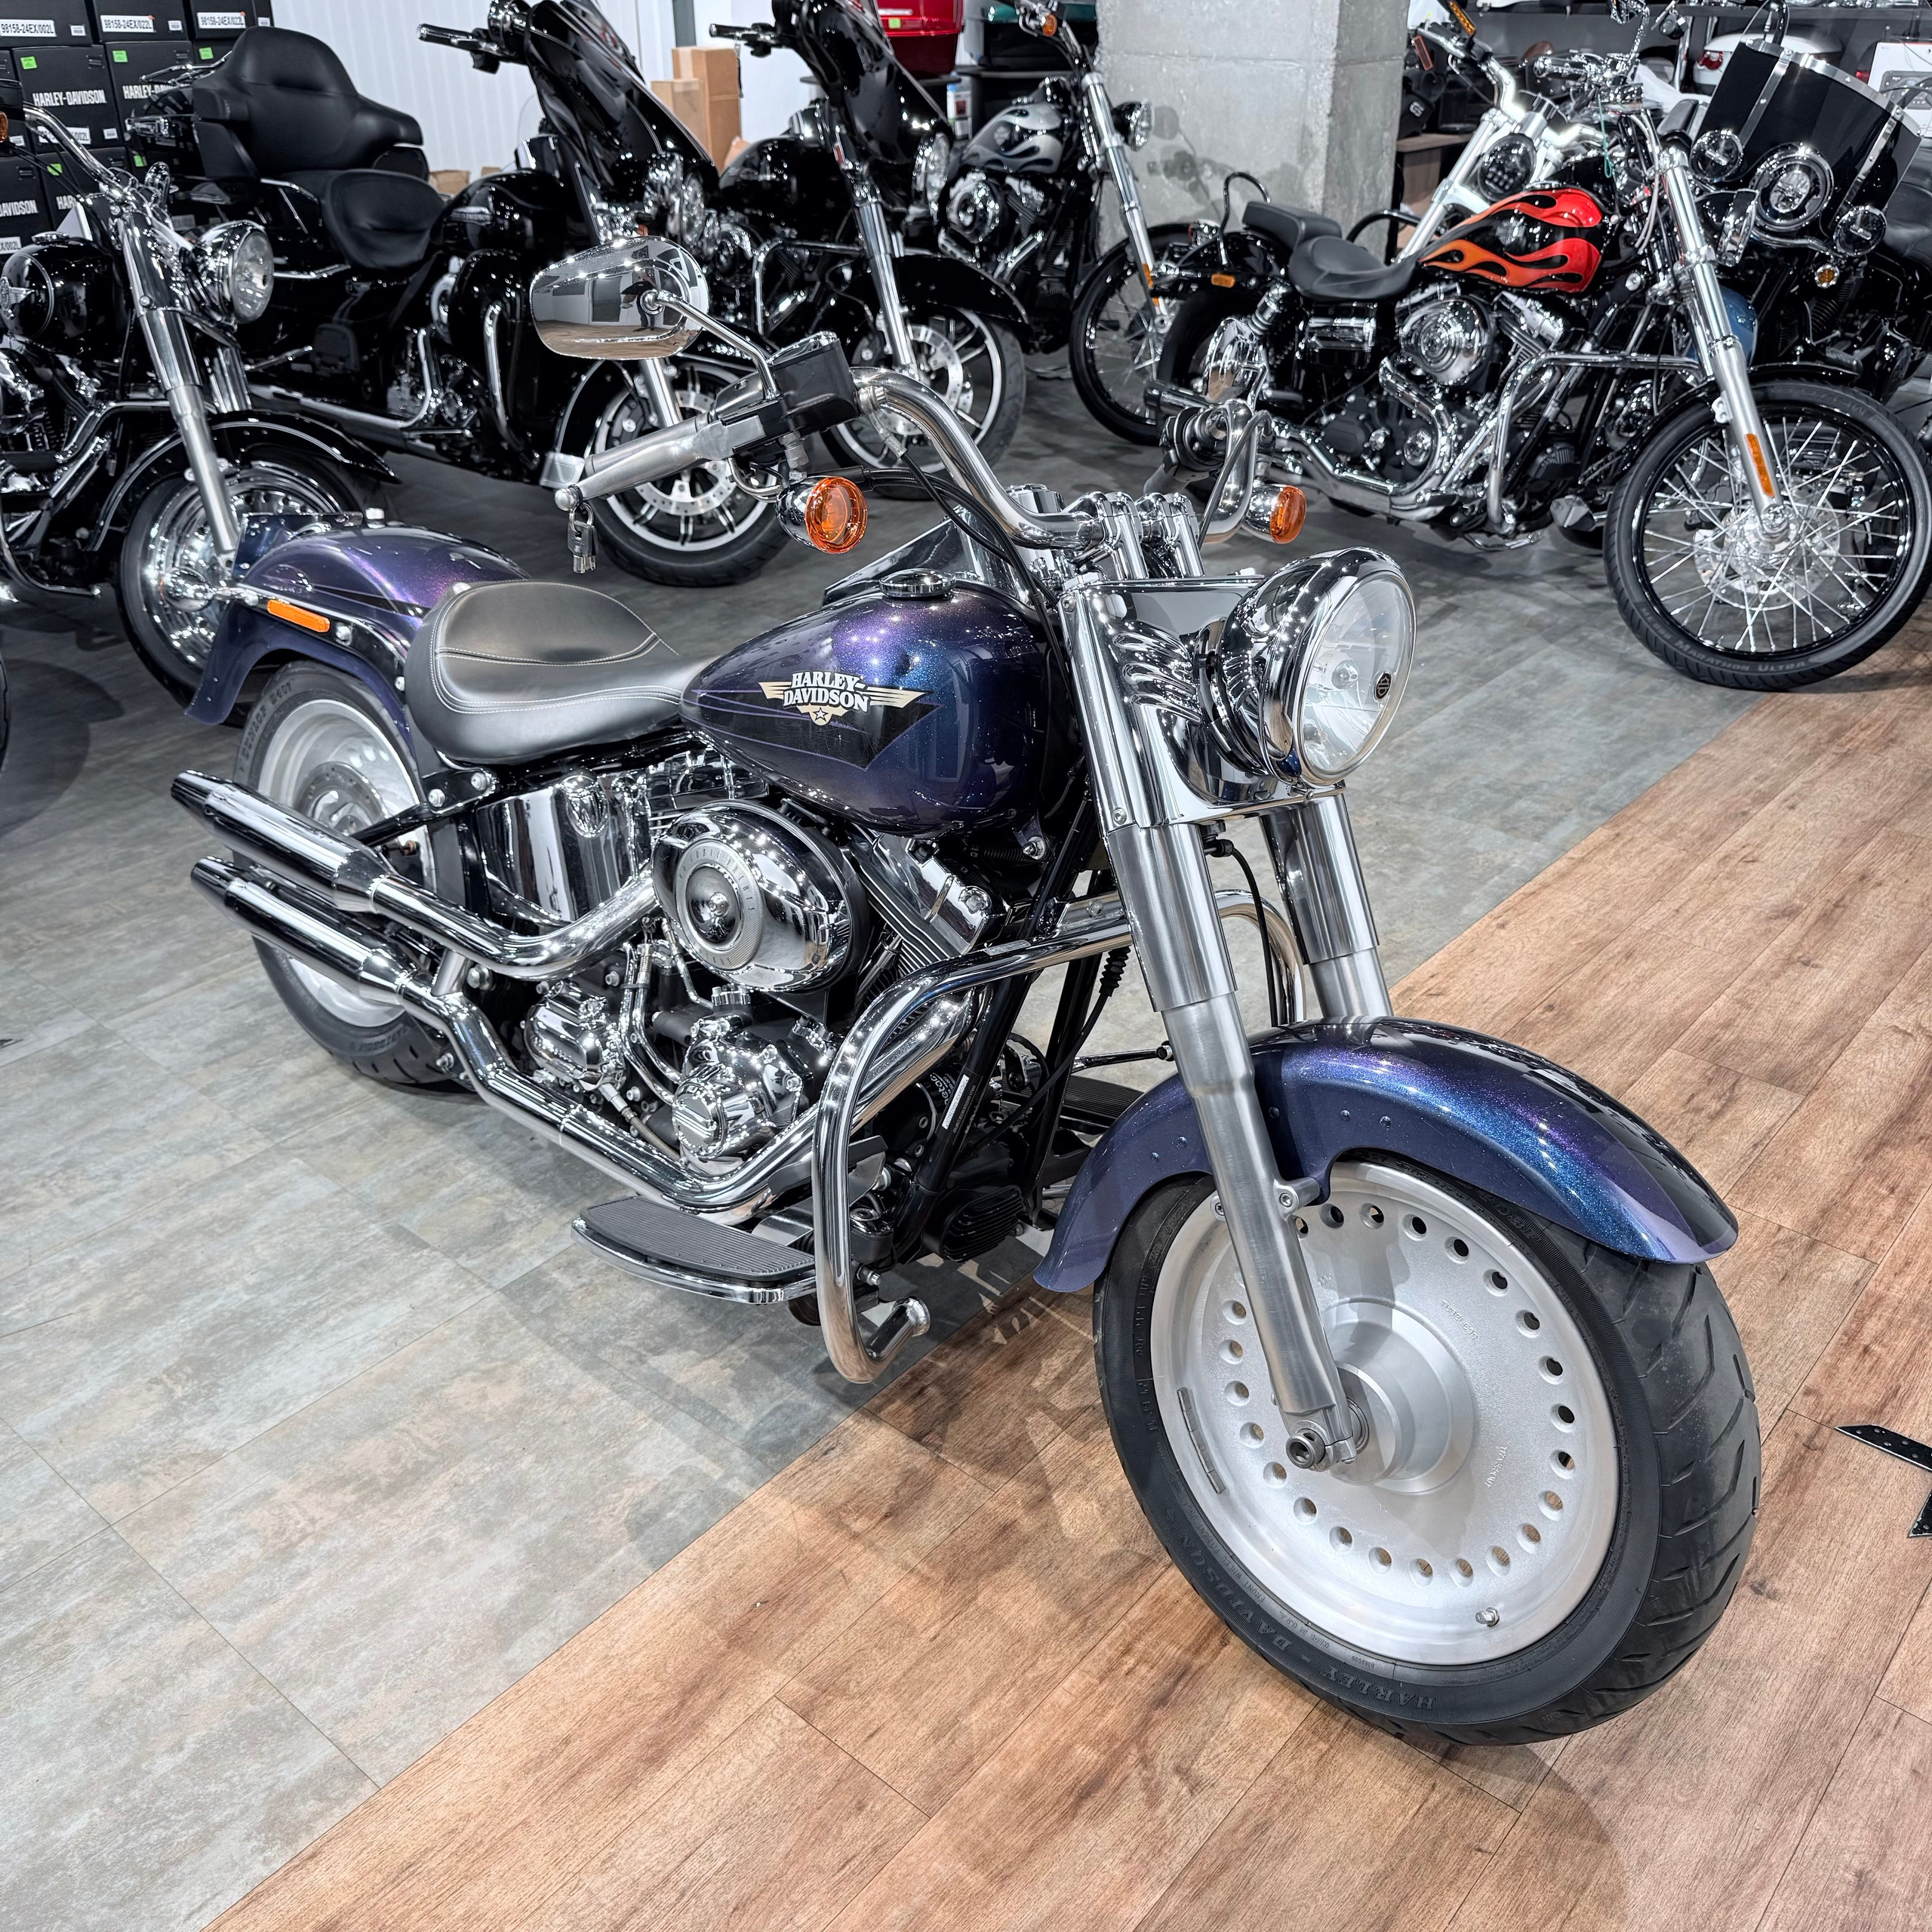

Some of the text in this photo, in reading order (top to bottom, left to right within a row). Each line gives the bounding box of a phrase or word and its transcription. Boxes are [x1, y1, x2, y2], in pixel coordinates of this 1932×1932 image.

[32, 89, 107, 106] HARLEY-DAVIDSON
[792, 671, 867, 691] HARLEY-
[783, 688, 869, 712] DAVIDSON
